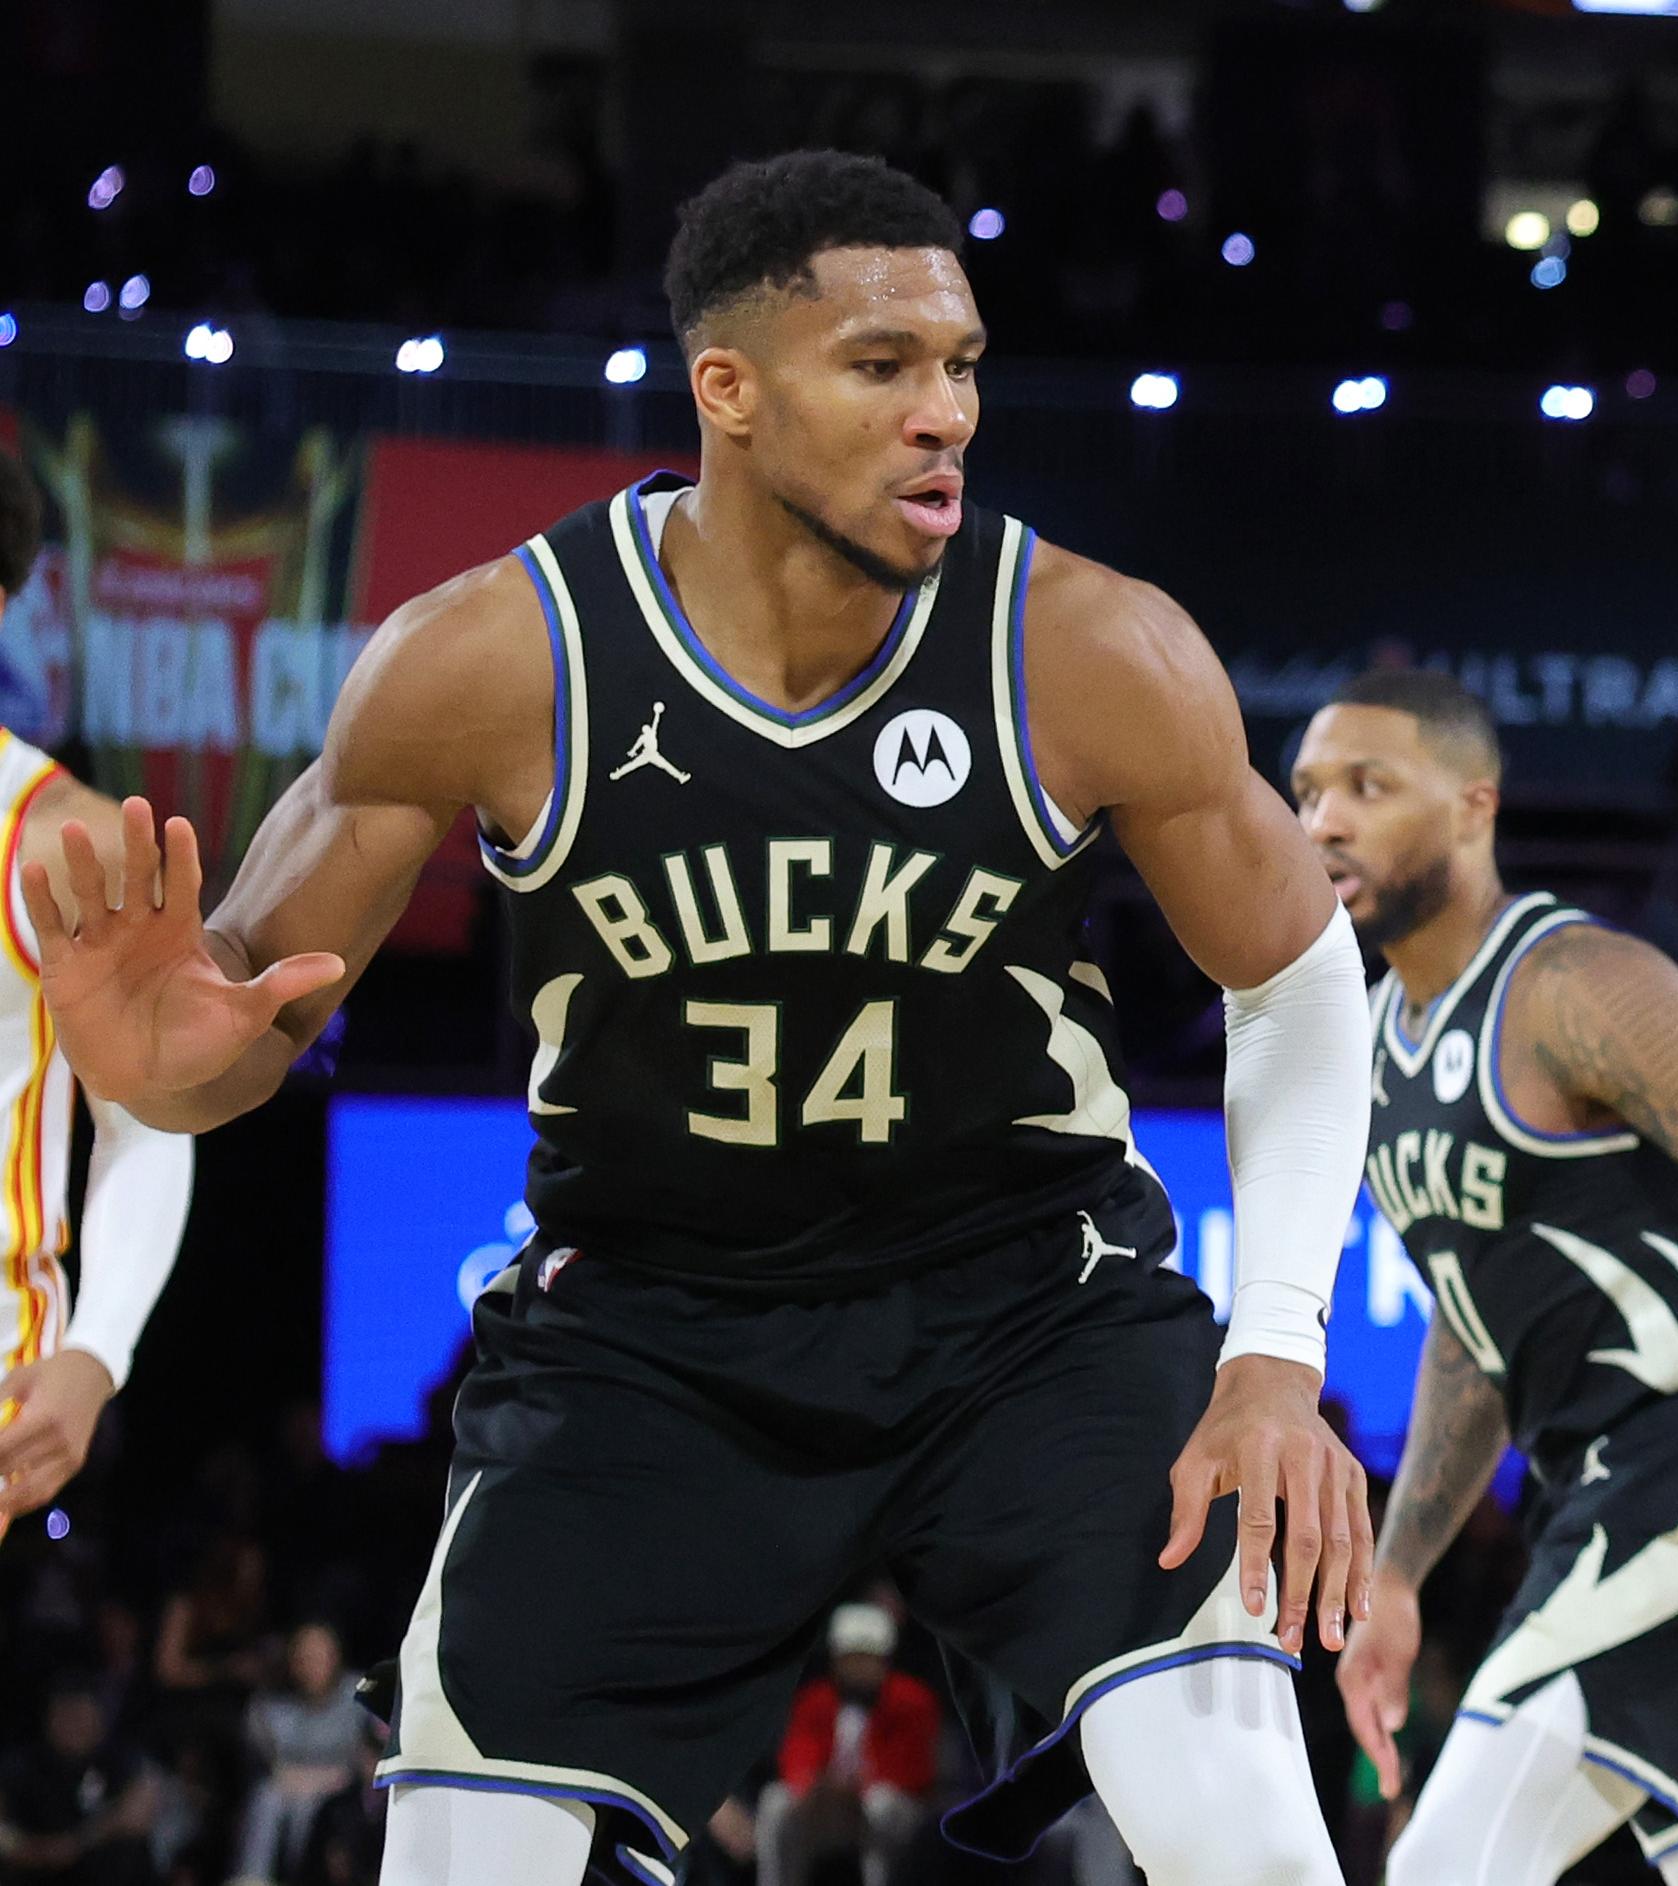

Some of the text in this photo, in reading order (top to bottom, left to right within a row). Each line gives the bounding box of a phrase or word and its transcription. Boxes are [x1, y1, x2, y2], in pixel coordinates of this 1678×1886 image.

[252, 614, 384, 758] CU
[571, 838, 1025, 980] BUCKS
[681, 998, 907, 1147] 34
[1366, 1127, 1507, 1231] UCKS
[1427, 1250, 1507, 1374] 0
